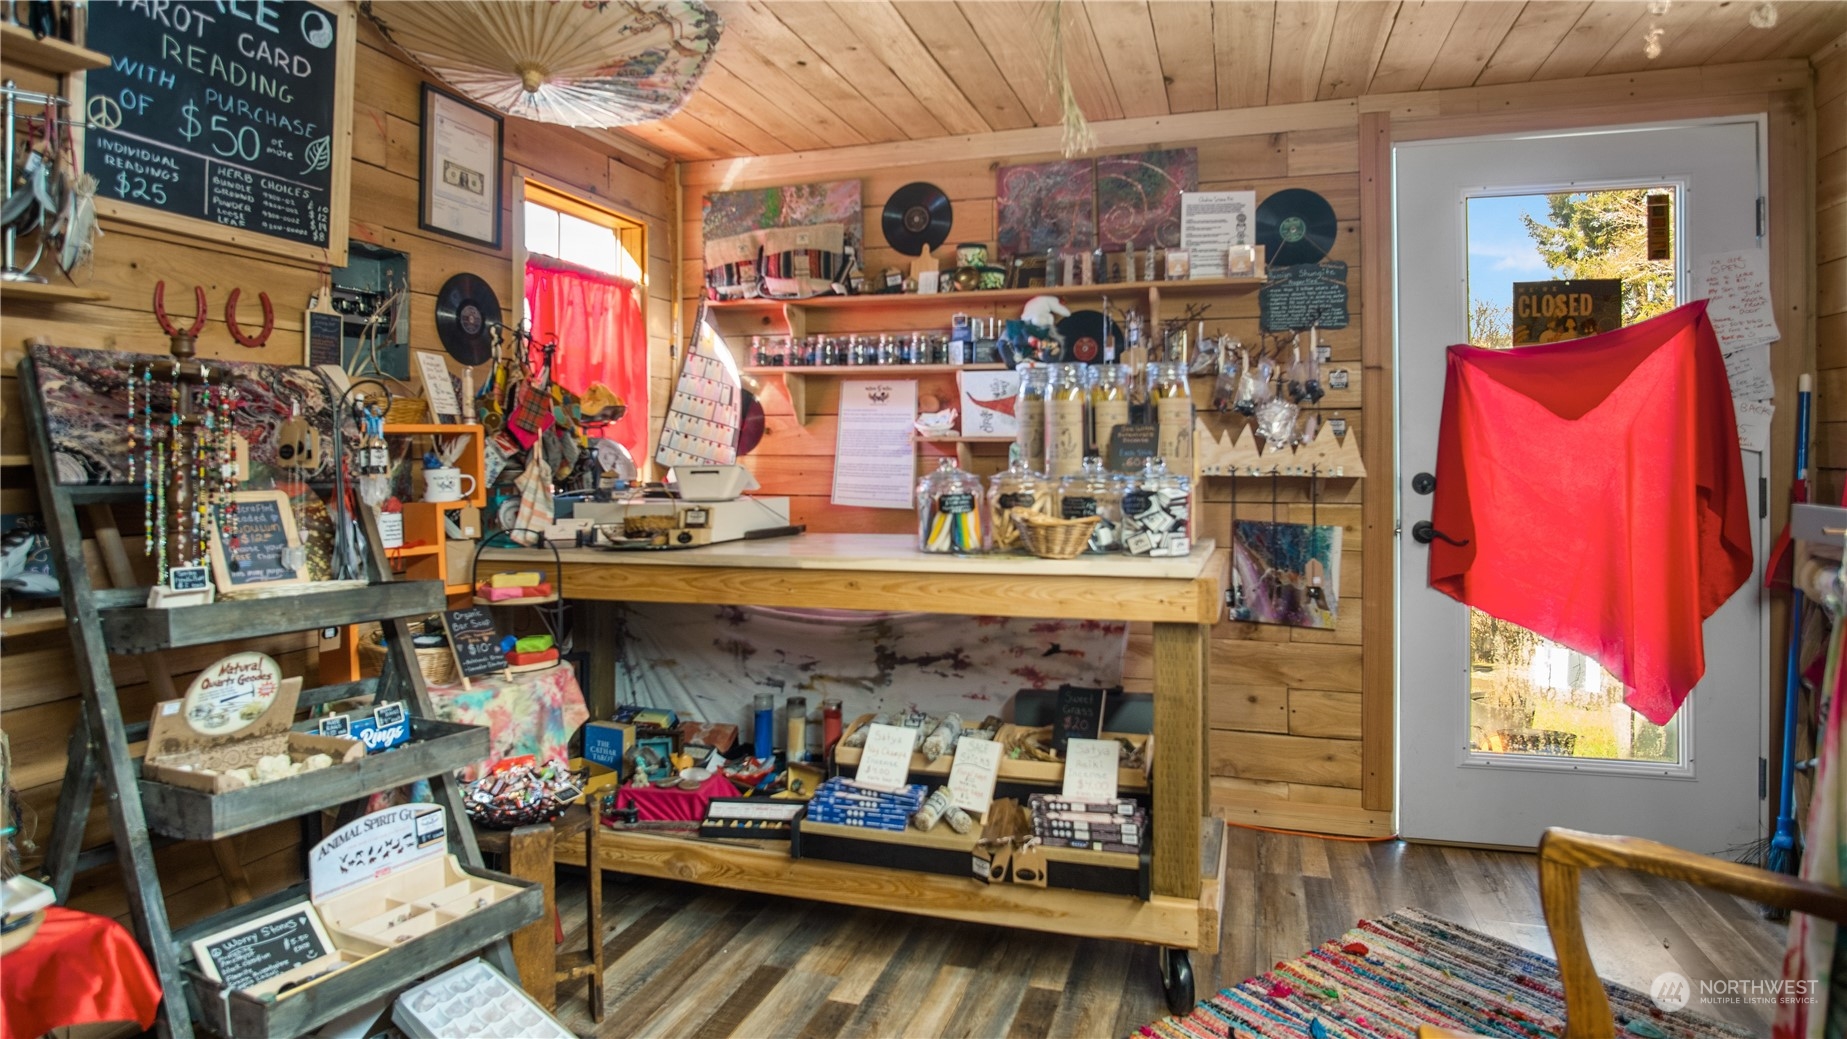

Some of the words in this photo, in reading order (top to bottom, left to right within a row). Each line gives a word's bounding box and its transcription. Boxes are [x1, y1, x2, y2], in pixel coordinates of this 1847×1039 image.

[116, 0, 215, 37] AROT
[238, 33, 312, 77] CARD
[162, 34, 295, 103] READING
[112, 55, 176, 90] WITH
[205, 88, 318, 139] PURCHASE
[120, 88, 154, 115] OF
[178, 98, 261, 161] $50
[97, 138, 180, 169] INDIVIDUAL
[266, 146, 295, 161] more
[104, 155, 180, 182] READINGS
[114, 171, 167, 204] $25
[213, 176, 252, 193] BUNDLE
[217, 166, 253, 183] HERB
[260, 178, 310, 199] CHOICES
[1517, 293, 1594, 318] CLOSED
[1740, 402, 1769, 416] BACK
[453, 608, 483, 620] Organic
[452, 623, 468, 632] Bar
[218, 656, 264, 677] Natural
[237, 669, 273, 686] Geodes
[1063, 715, 1089, 730] $20
[360, 725, 404, 748] Rings
[596, 739, 610, 748] THE
[589, 746, 617, 756] CATHAR
[592, 753, 615, 763] TAROT
[1075, 743, 1111, 758] Satya
[317, 825, 362, 861] ANIMAL
[363, 811, 398, 832] SPIRIT
[399, 808, 417, 821] GU
[222, 932, 259, 950] Worry
[260, 919, 298, 938] Stones
